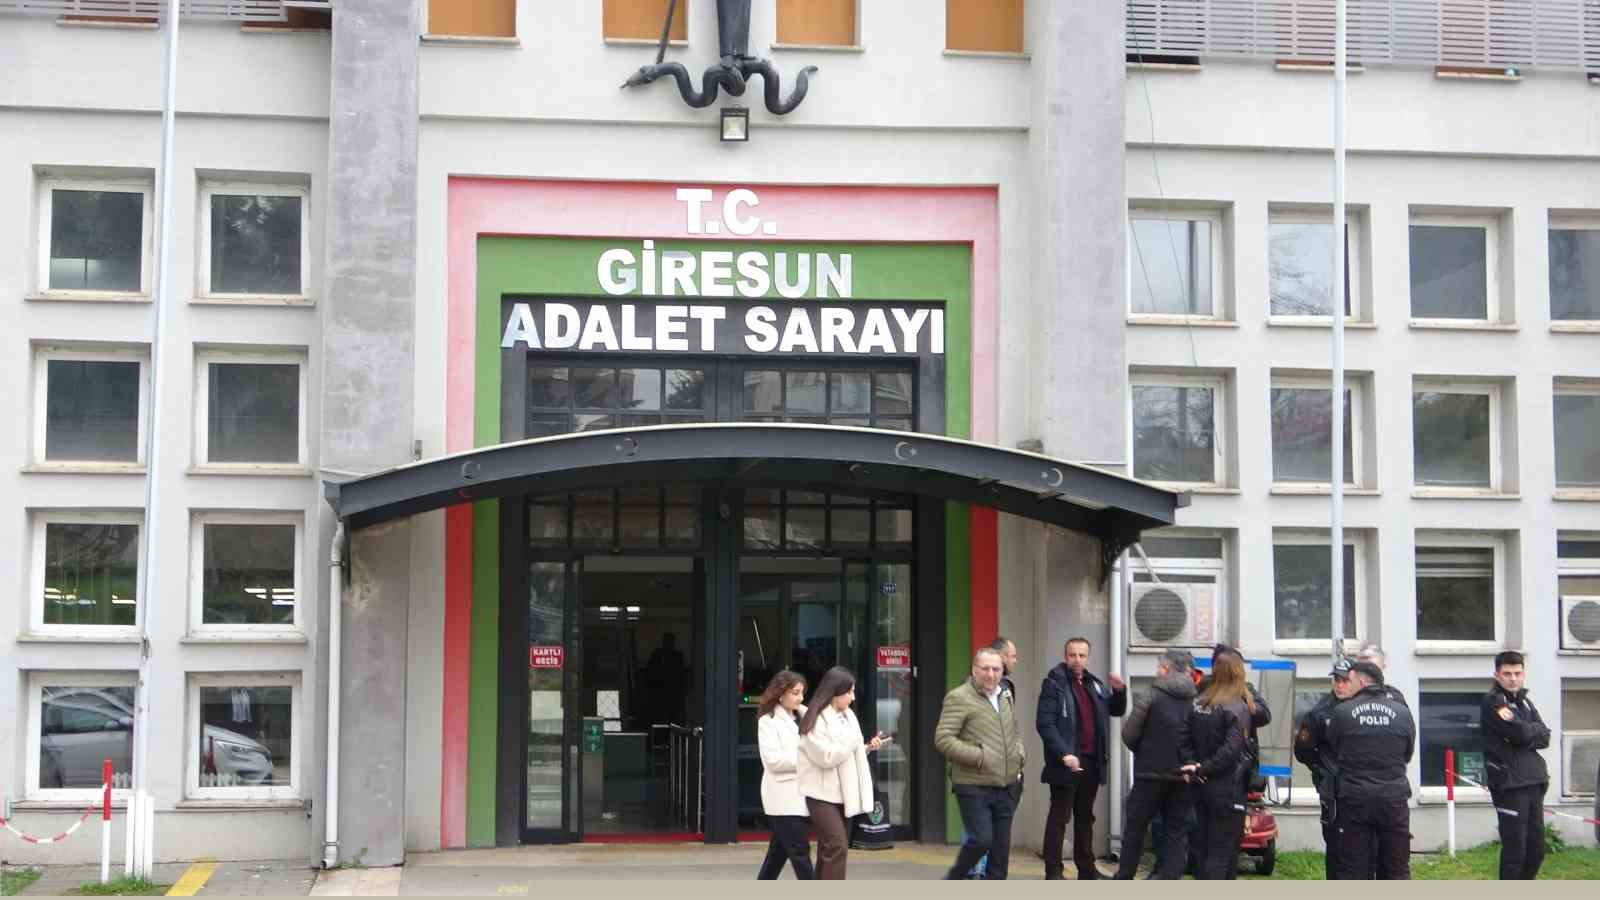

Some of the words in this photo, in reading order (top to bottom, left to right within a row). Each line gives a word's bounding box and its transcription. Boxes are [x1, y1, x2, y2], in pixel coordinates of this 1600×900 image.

[676, 188, 777, 236] T.C.
[597, 239, 852, 299] GİRESUN
[501, 302, 726, 351] ADALET
[744, 306, 945, 354] SARAYI
